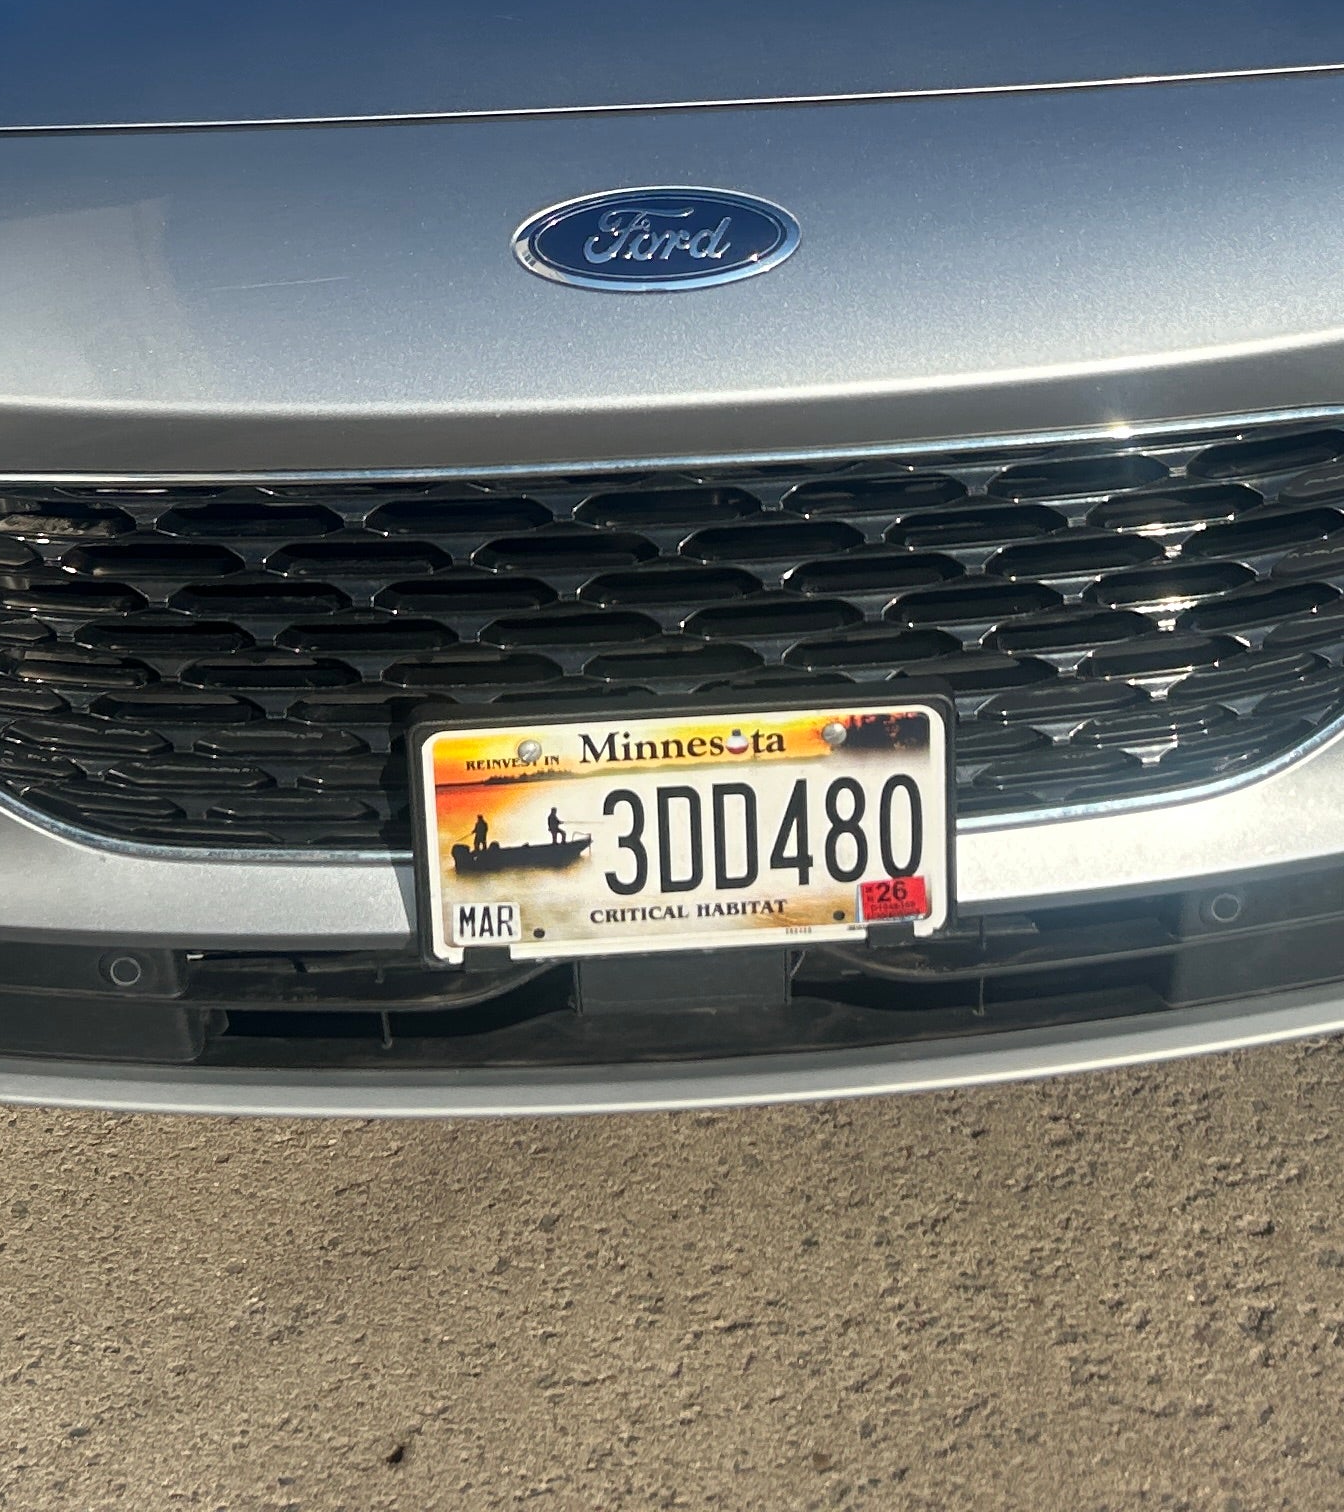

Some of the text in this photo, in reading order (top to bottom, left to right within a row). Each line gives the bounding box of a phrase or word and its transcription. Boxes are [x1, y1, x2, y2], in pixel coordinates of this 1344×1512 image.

[583, 207, 732, 264] Ford
[544, 754, 560, 766] IN
[602, 773, 924, 896] 3DD480
[875, 880, 908, 903] 26
[459, 905, 514, 939] MAR
[590, 898, 789, 924] CRITICAL HABITAT
